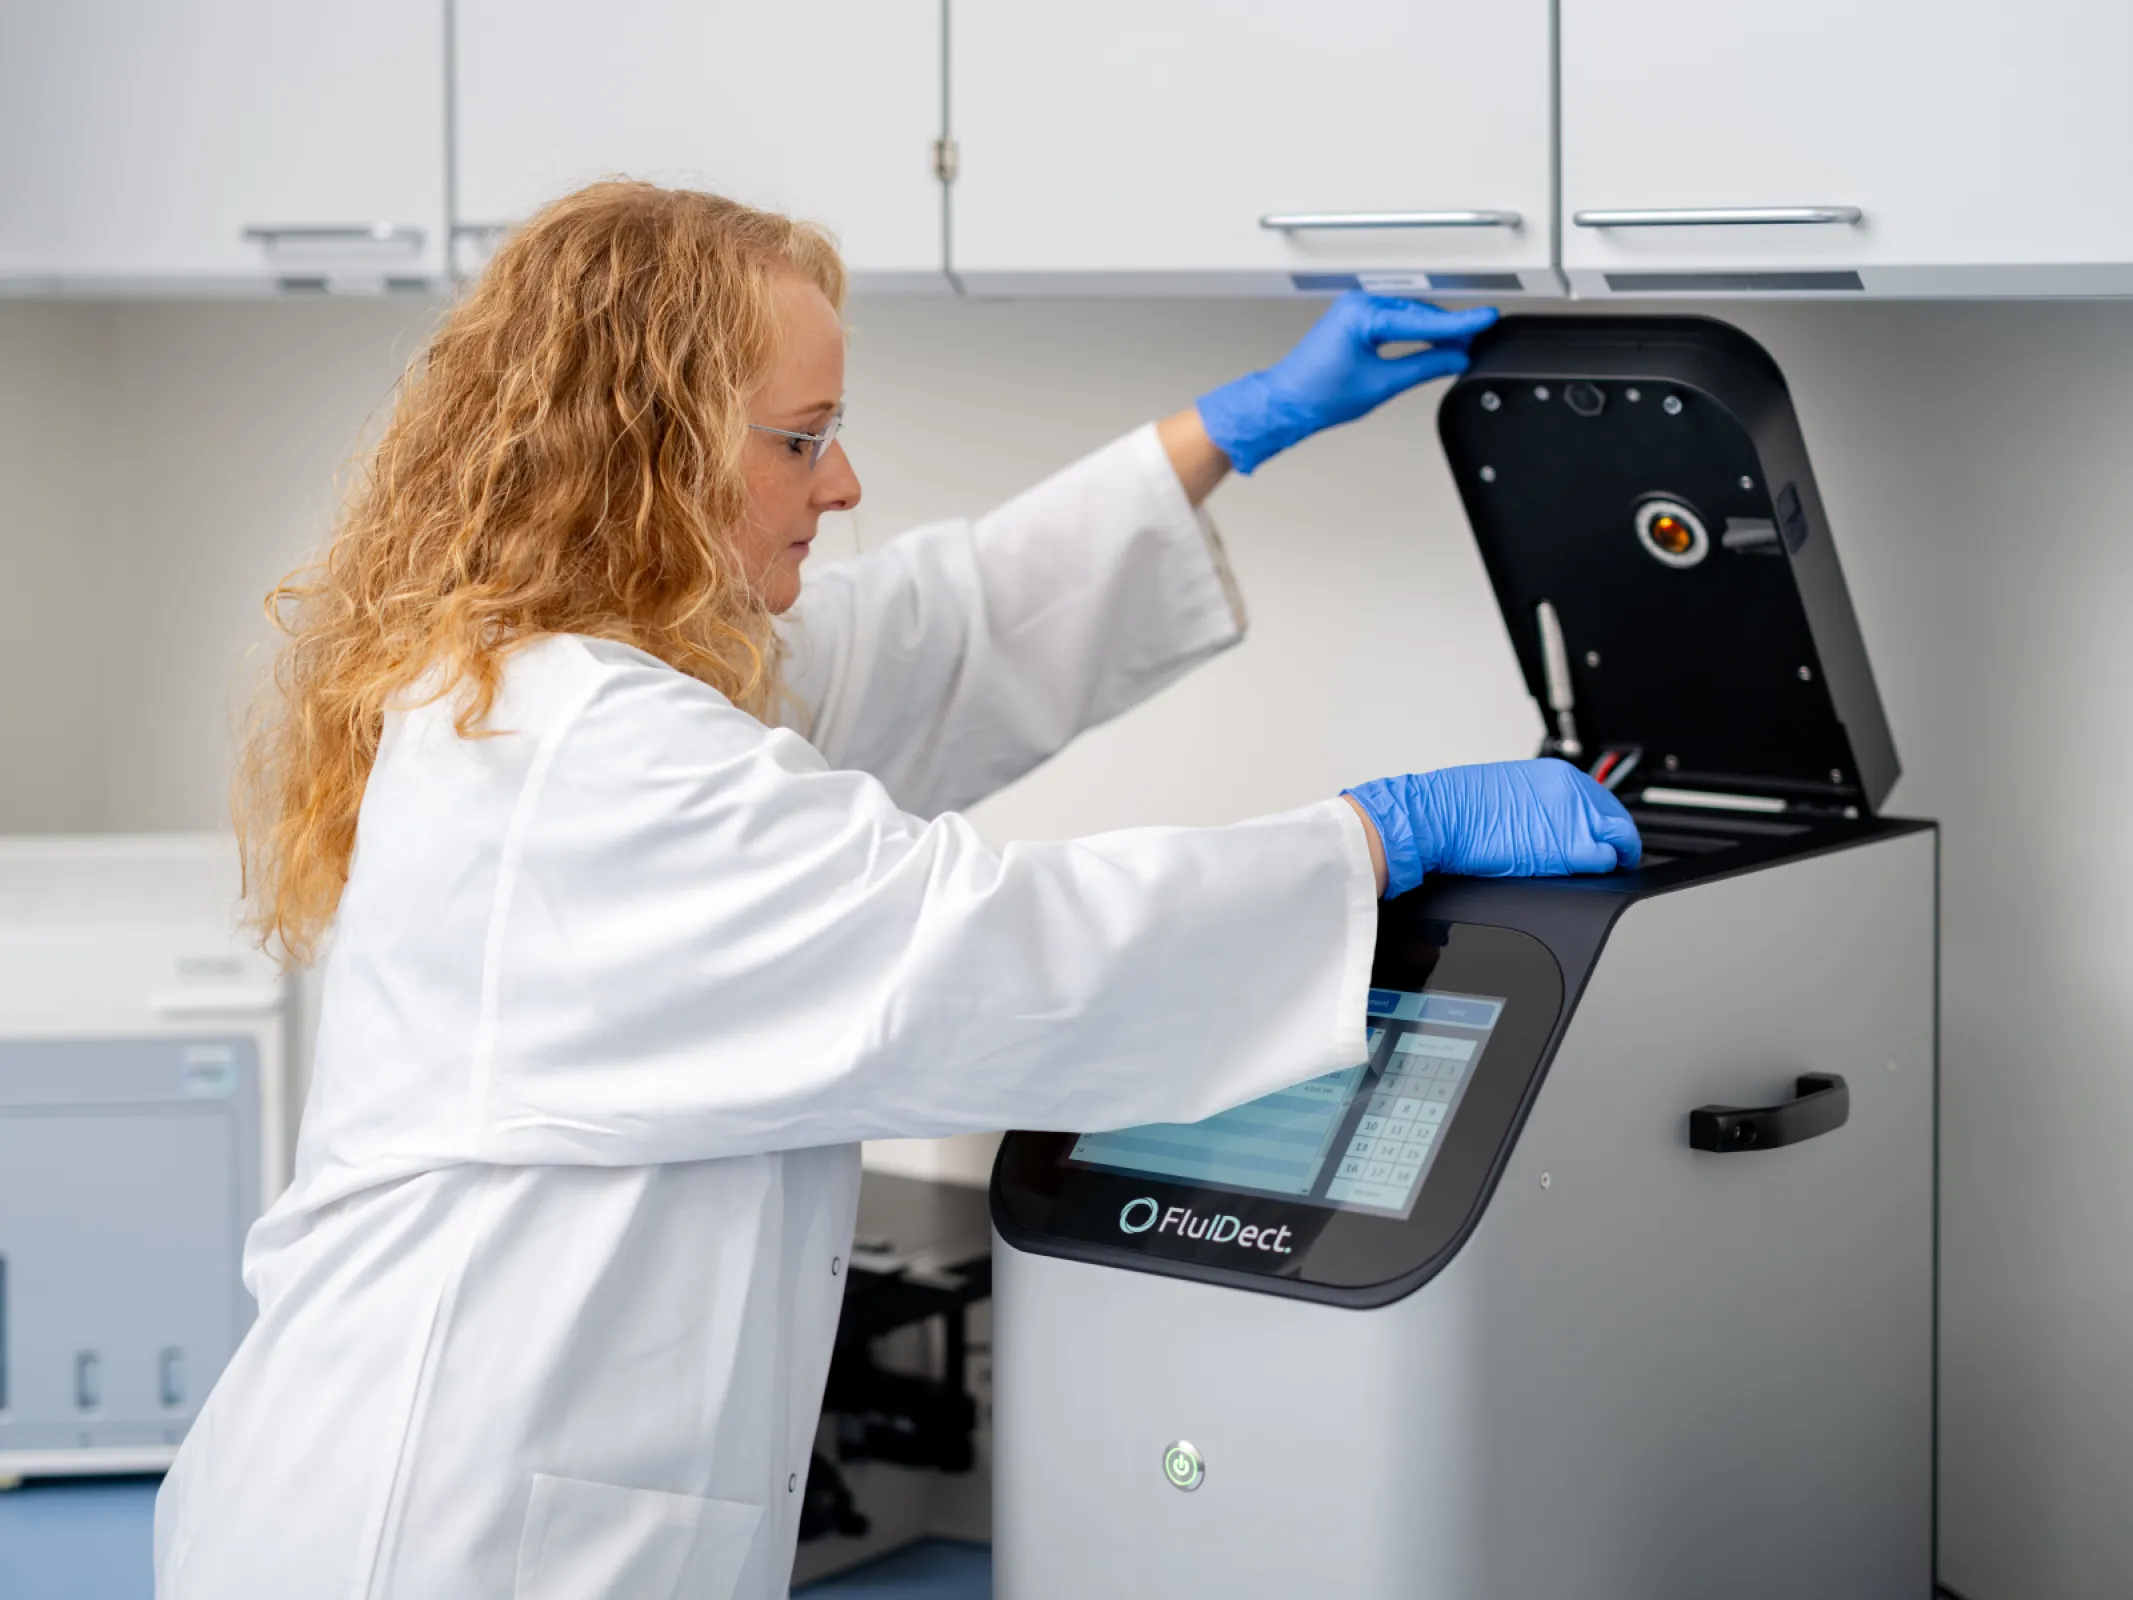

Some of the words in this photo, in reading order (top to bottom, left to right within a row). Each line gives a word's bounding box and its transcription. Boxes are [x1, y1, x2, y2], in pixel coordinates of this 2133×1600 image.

[1402, 1104, 1411, 1113] 8
[1429, 1107, 1437, 1116] 9
[1364, 1121, 1378, 1131] 10
[1390, 1124, 1403, 1135] 11
[1417, 1129, 1430, 1139] 12
[1355, 1142, 1369, 1152] 13
[1380, 1146, 1394, 1156] 14
[1407, 1149, 1420, 1160] 15
[1345, 1163, 1359, 1174] 16
[1371, 1167, 1384, 1177] 17
[1397, 1170, 1410, 1181] 18
